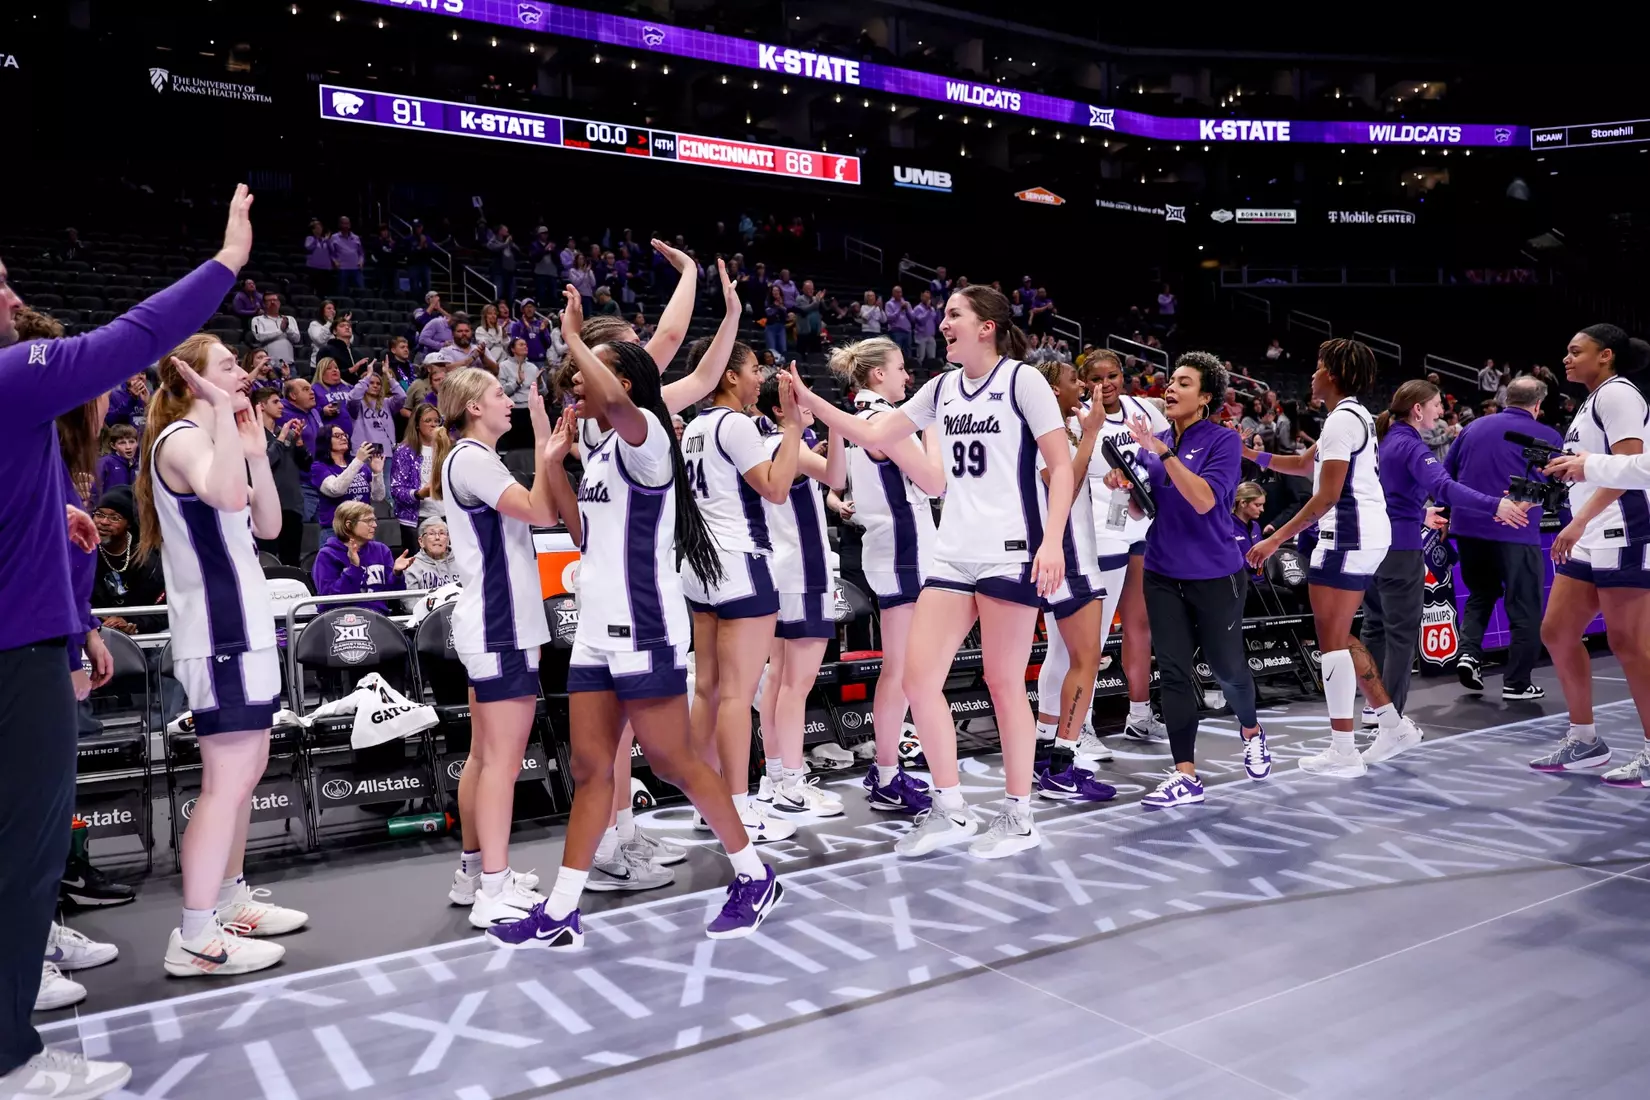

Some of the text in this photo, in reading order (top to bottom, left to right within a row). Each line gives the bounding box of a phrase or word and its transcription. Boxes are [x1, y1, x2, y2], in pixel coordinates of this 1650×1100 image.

[172, 74, 256, 93] THE UNIVERSITY OF
[173, 83, 272, 103] KANSAS HEALTH SYSTEM
[758, 43, 860, 85] K-STATE
[944, 81, 1022, 112] WILDCATS
[1199, 119, 1291, 141] K-STATE
[1368, 124, 1461, 143] WILDCATS
[392, 98, 425, 127] 91
[460, 110, 546, 139] K-STATE
[586, 123, 627, 145] 00.0
[654, 138, 674, 151] 4TH
[679, 139, 775, 169] CINCINNATI
[785, 151, 812, 175] 66
[1536, 126, 1634, 143] NCAAW Stonehill
[893, 165, 952, 188] UMB
[1376, 213, 1412, 224] CENTER
[944, 413, 1001, 436] Wildcats
[685, 434, 705, 454] COTTON
[951, 440, 987, 478] 99
[685, 457, 709, 499] 24
[1422, 610, 1451, 623] PHILLIPS
[334, 623, 369, 643] XII
[1426, 627, 1451, 652] 66
[1264, 655, 1292, 668] Allstate
[949, 698, 990, 713] Allstate
[77, 747, 120, 756] ERENCE
[354, 776, 420, 795] Allstate
[250, 793, 289, 810] tate
